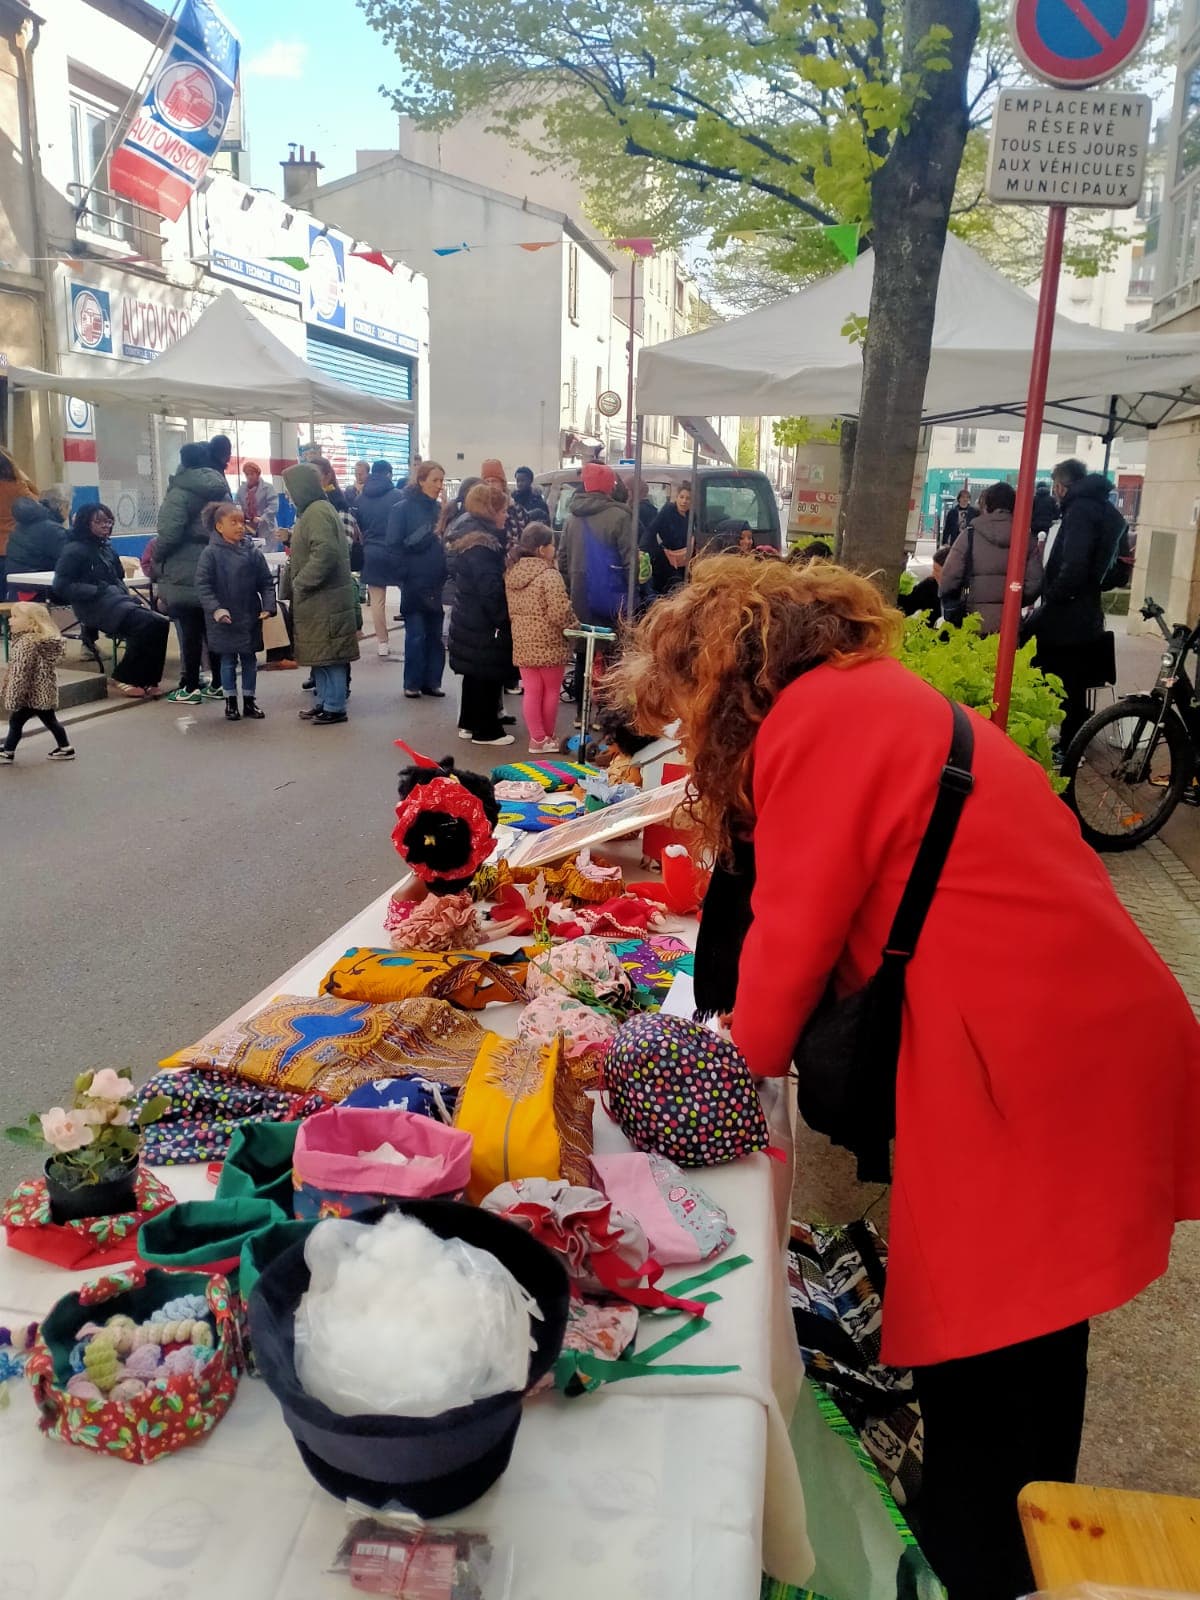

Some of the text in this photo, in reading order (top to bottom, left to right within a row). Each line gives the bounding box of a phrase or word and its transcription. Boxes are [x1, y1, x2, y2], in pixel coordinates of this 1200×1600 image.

[1004, 99, 1144, 117] EMPLACEMENT
[1027, 117, 1116, 136] RÉSERVÉ
[127, 117, 208, 178] AUTOVISION
[1001, 138, 1138, 157] TOUS LES JOURS
[998, 158, 1136, 177] AUX VÉHICULES
[1006, 178, 1128, 197] MUNICIPAUX
